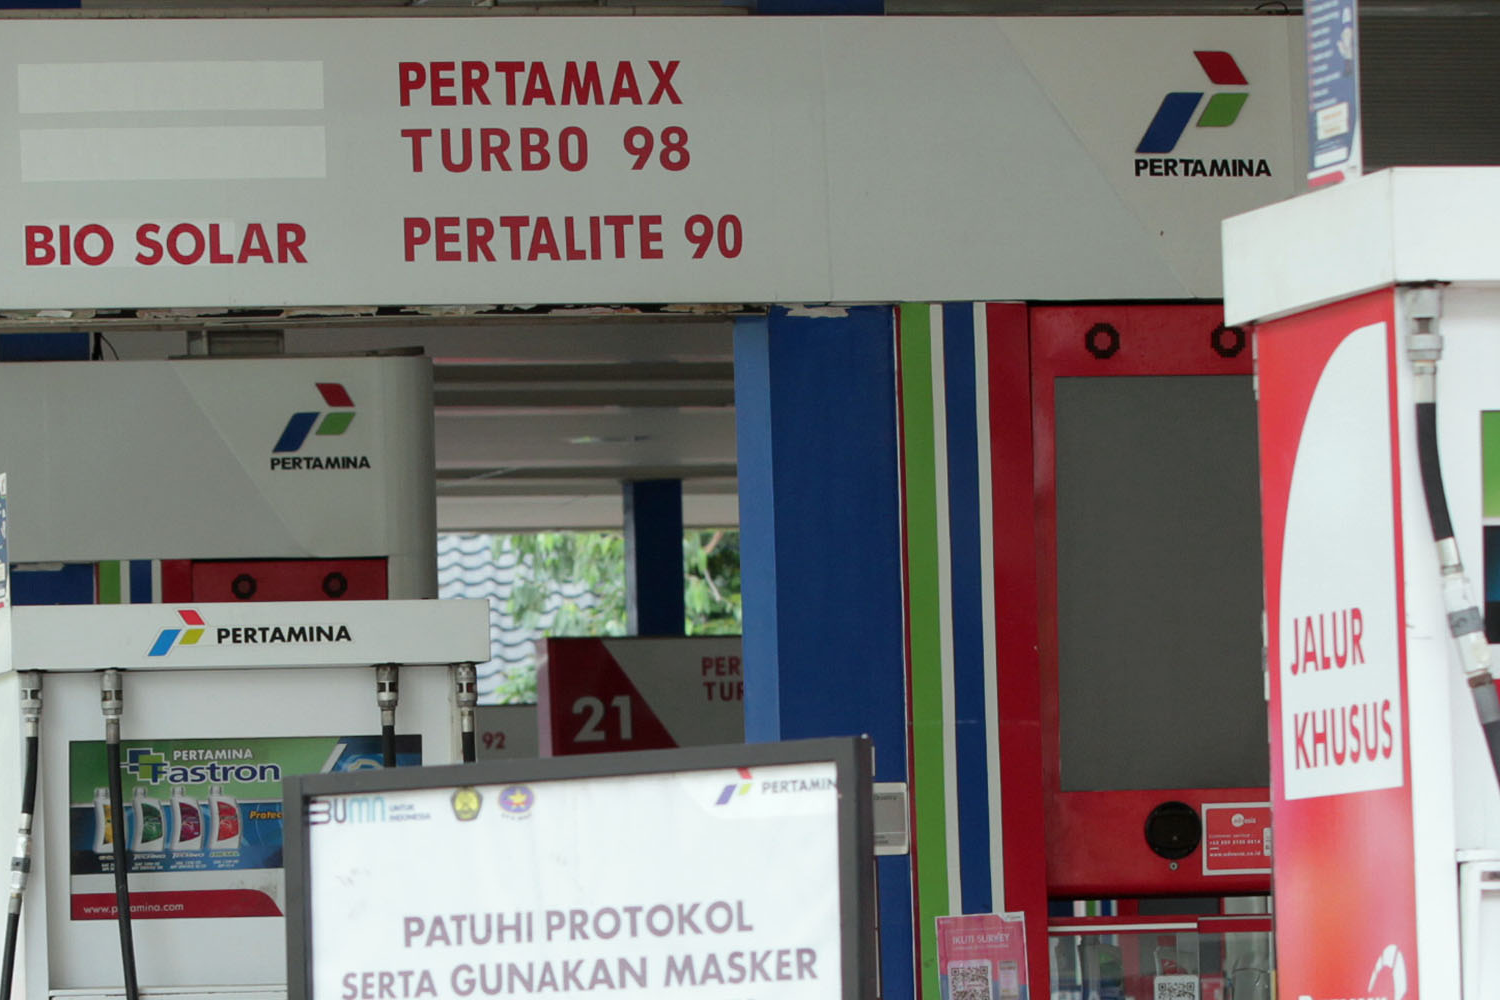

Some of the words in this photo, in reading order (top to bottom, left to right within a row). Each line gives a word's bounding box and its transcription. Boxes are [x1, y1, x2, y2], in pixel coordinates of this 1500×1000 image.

[399, 60, 681, 106] PERTAMAX
[400, 128, 588, 172] TURBO
[624, 126, 691, 170] 98
[1134, 158, 1271, 178] PERTAMINA
[25, 225, 113, 266] BIO
[136, 223, 307, 264] SOLAR
[403, 215, 663, 262] PERTALITE
[683, 214, 742, 258] 90
[270, 456, 371, 470] PERTAMINA
[217, 625, 351, 644] PERTAMINA
[1290, 607, 1365, 676] JALUR
[482, 732, 505, 749] 92
[572, 695, 632, 742] 21
[1294, 699, 1392, 770] KHUSUS
[151, 763, 280, 784] Fastron
[173, 749, 253, 761] PERTAMINA
[84, 903, 184, 915] www.pamina.com
[403, 912, 533, 949] PATUHI
[547, 900, 753, 941] PROTOKOL
[342, 968, 438, 1000] SERTA
[450, 956, 648, 997] GUNAKAN
[663, 948, 818, 988] MASKER
